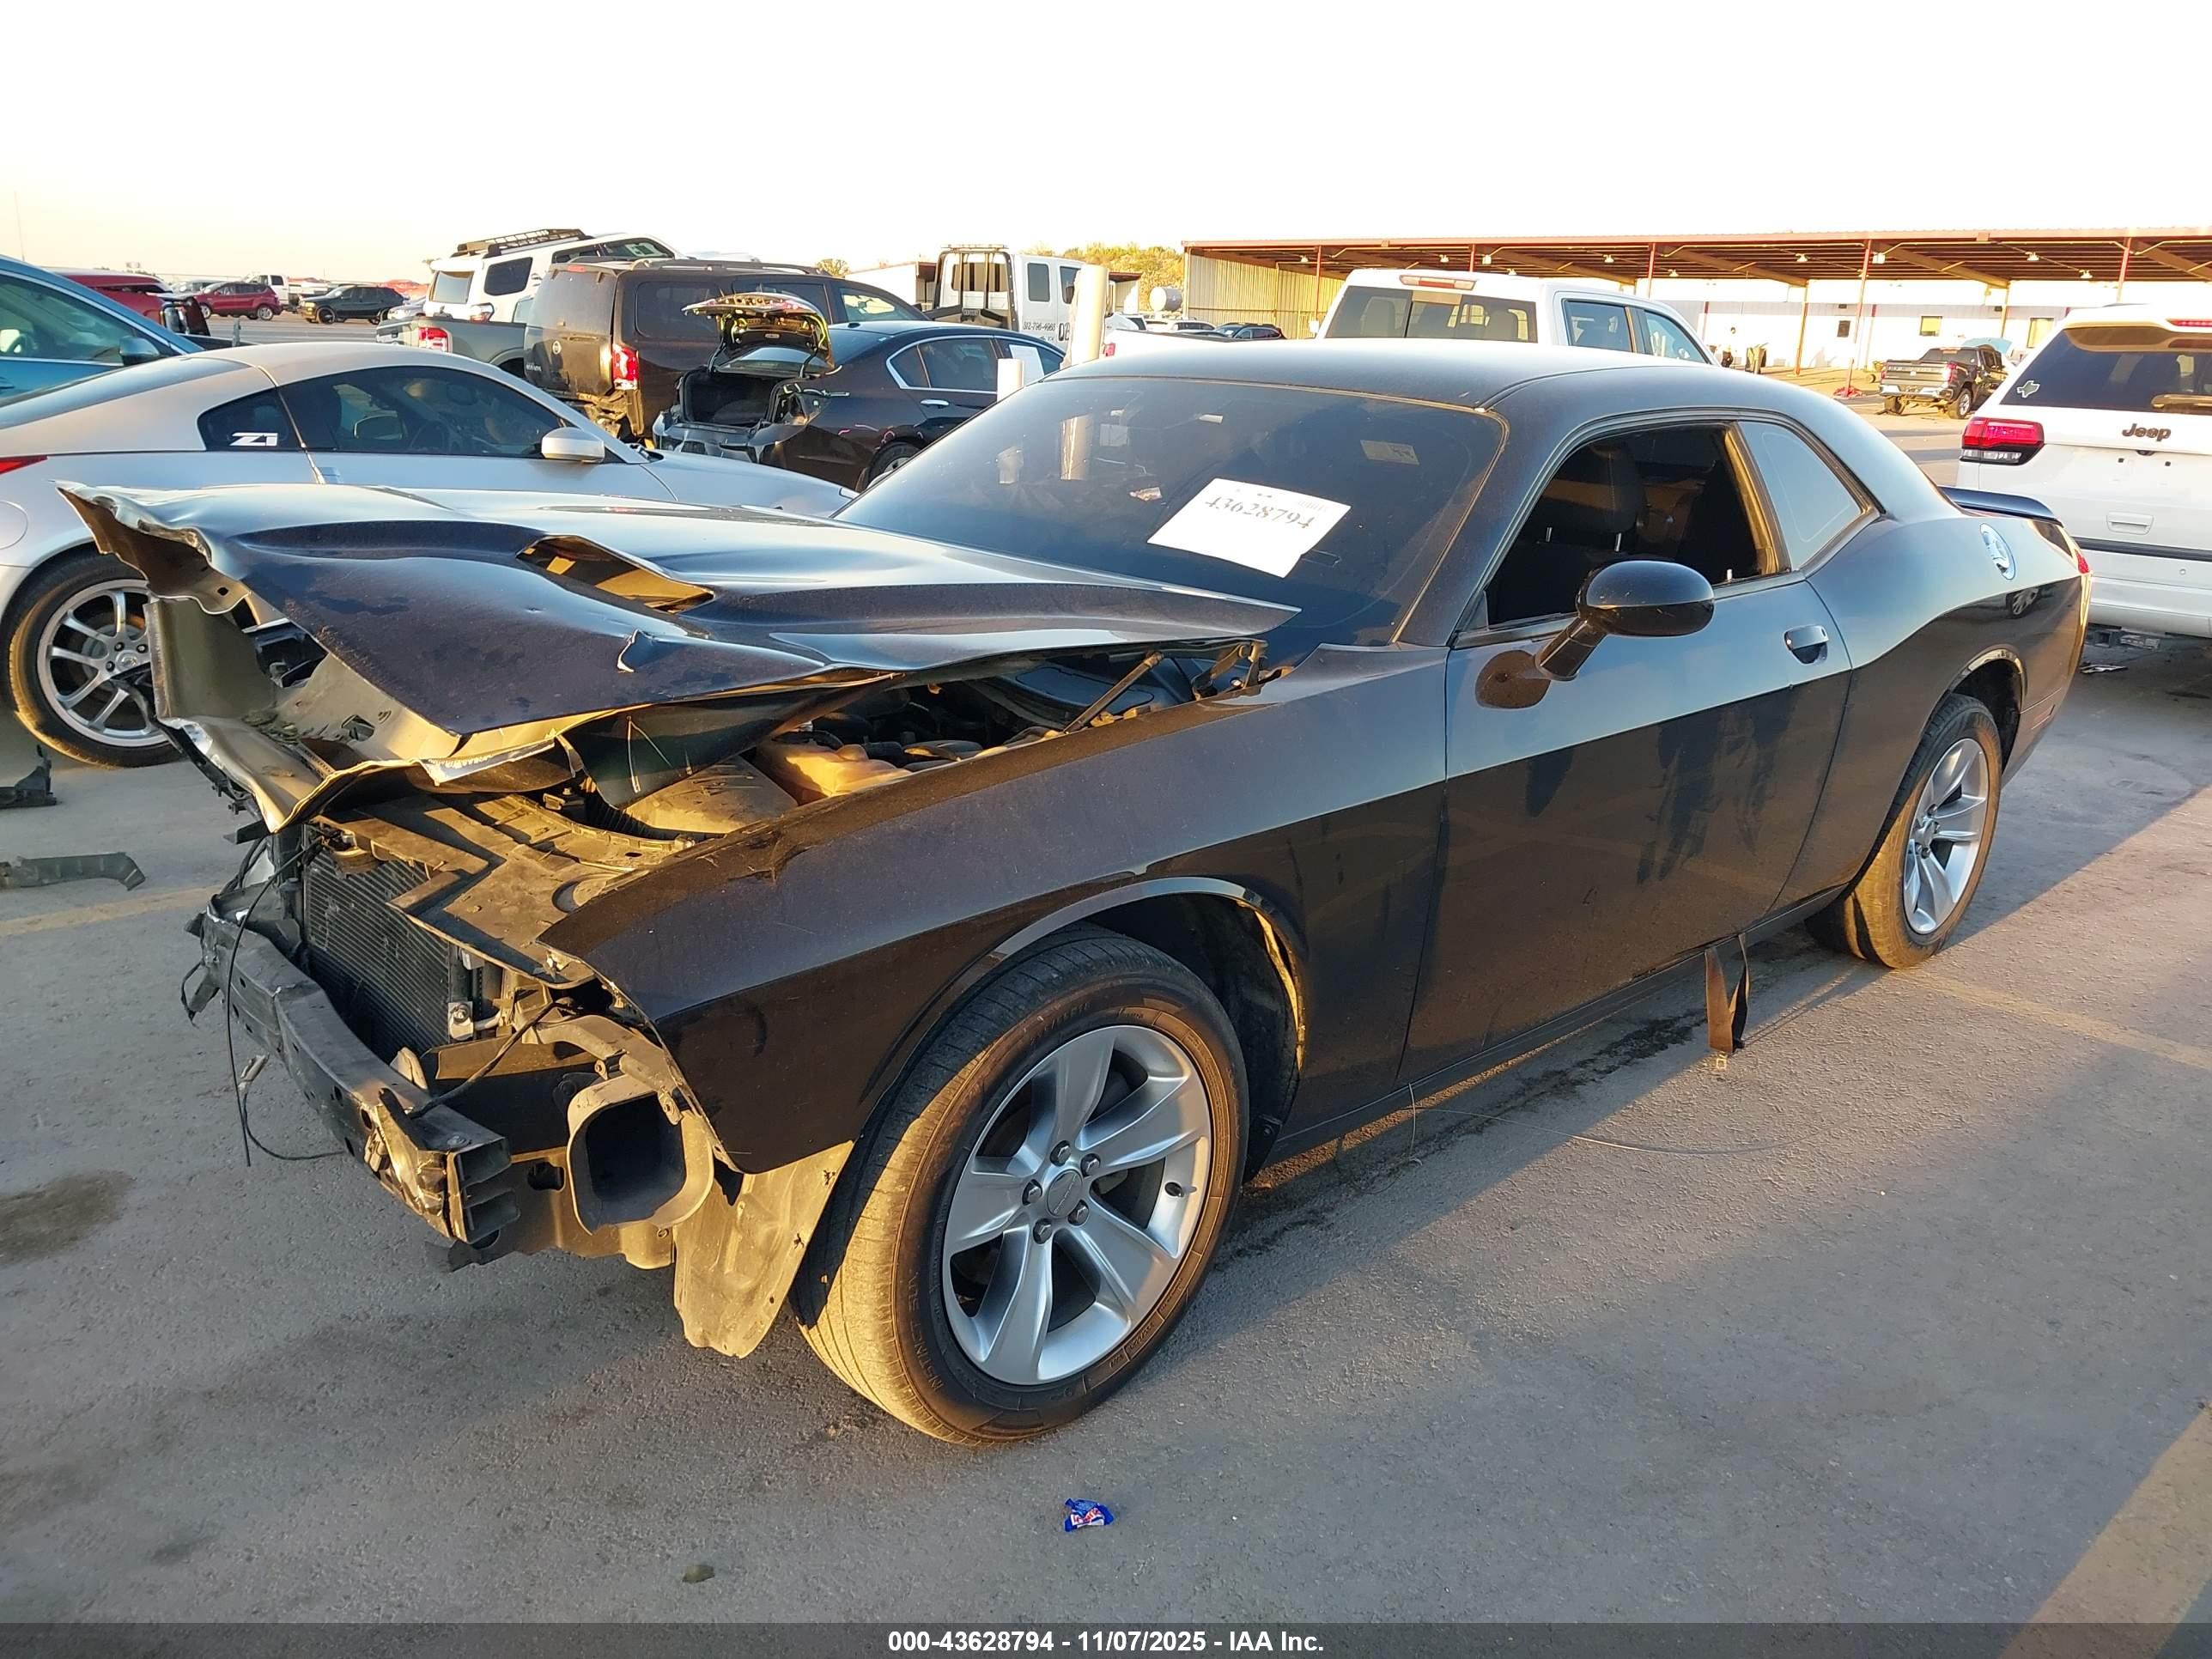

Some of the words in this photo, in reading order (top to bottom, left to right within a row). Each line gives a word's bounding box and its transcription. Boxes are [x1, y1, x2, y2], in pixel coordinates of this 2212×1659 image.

[229, 432, 278, 447] Z1
[2122, 423, 2171, 441] Jeep
[1205, 495, 1316, 529] 43628794
